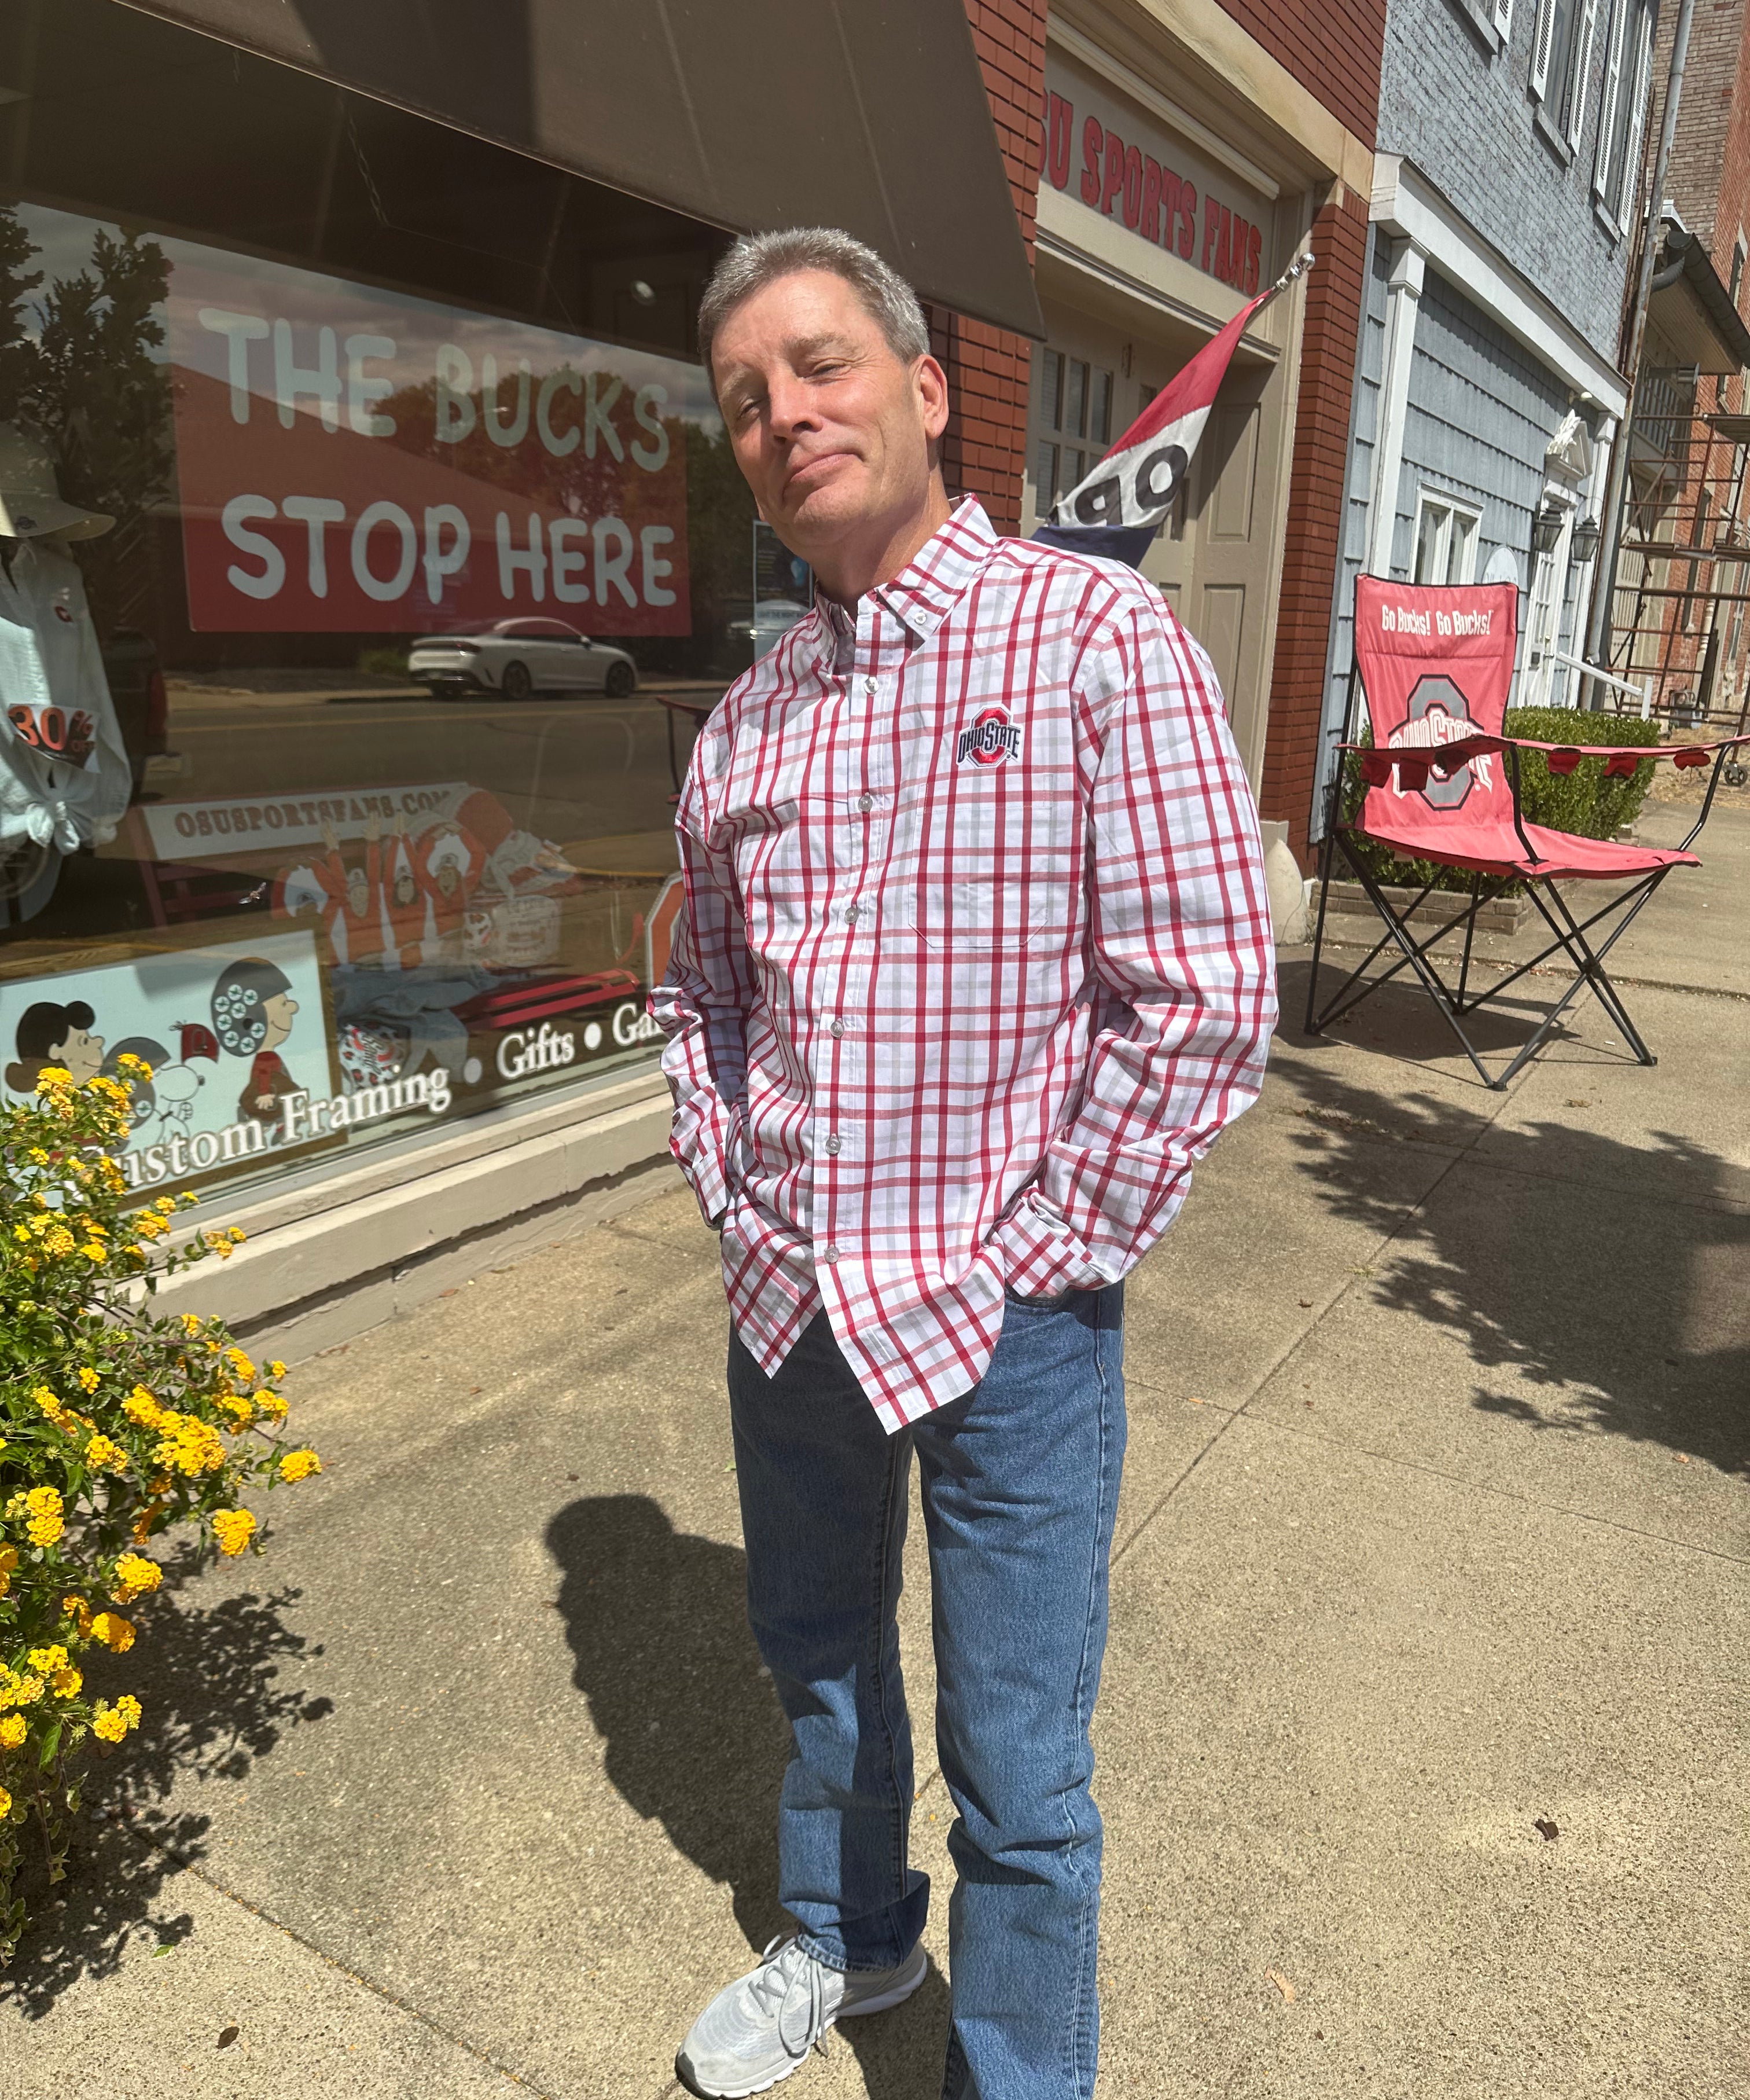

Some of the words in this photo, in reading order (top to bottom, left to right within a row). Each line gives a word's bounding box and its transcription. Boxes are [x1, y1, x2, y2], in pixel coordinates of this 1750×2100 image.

[1039, 87, 1073, 190] U
[1080, 116, 1197, 260] SPORTS
[1202, 194, 1262, 296] FANS
[198, 307, 396, 438] THE
[435, 343, 669, 472] BUCKS
[221, 493, 472, 604] STOP
[496, 511, 677, 608] HERE
[957, 726, 985, 763] OHIO
[984, 722, 1021, 759] STATE
[278, 1067, 451, 1143] Framing
[496, 1022, 575, 1080] Gifts
